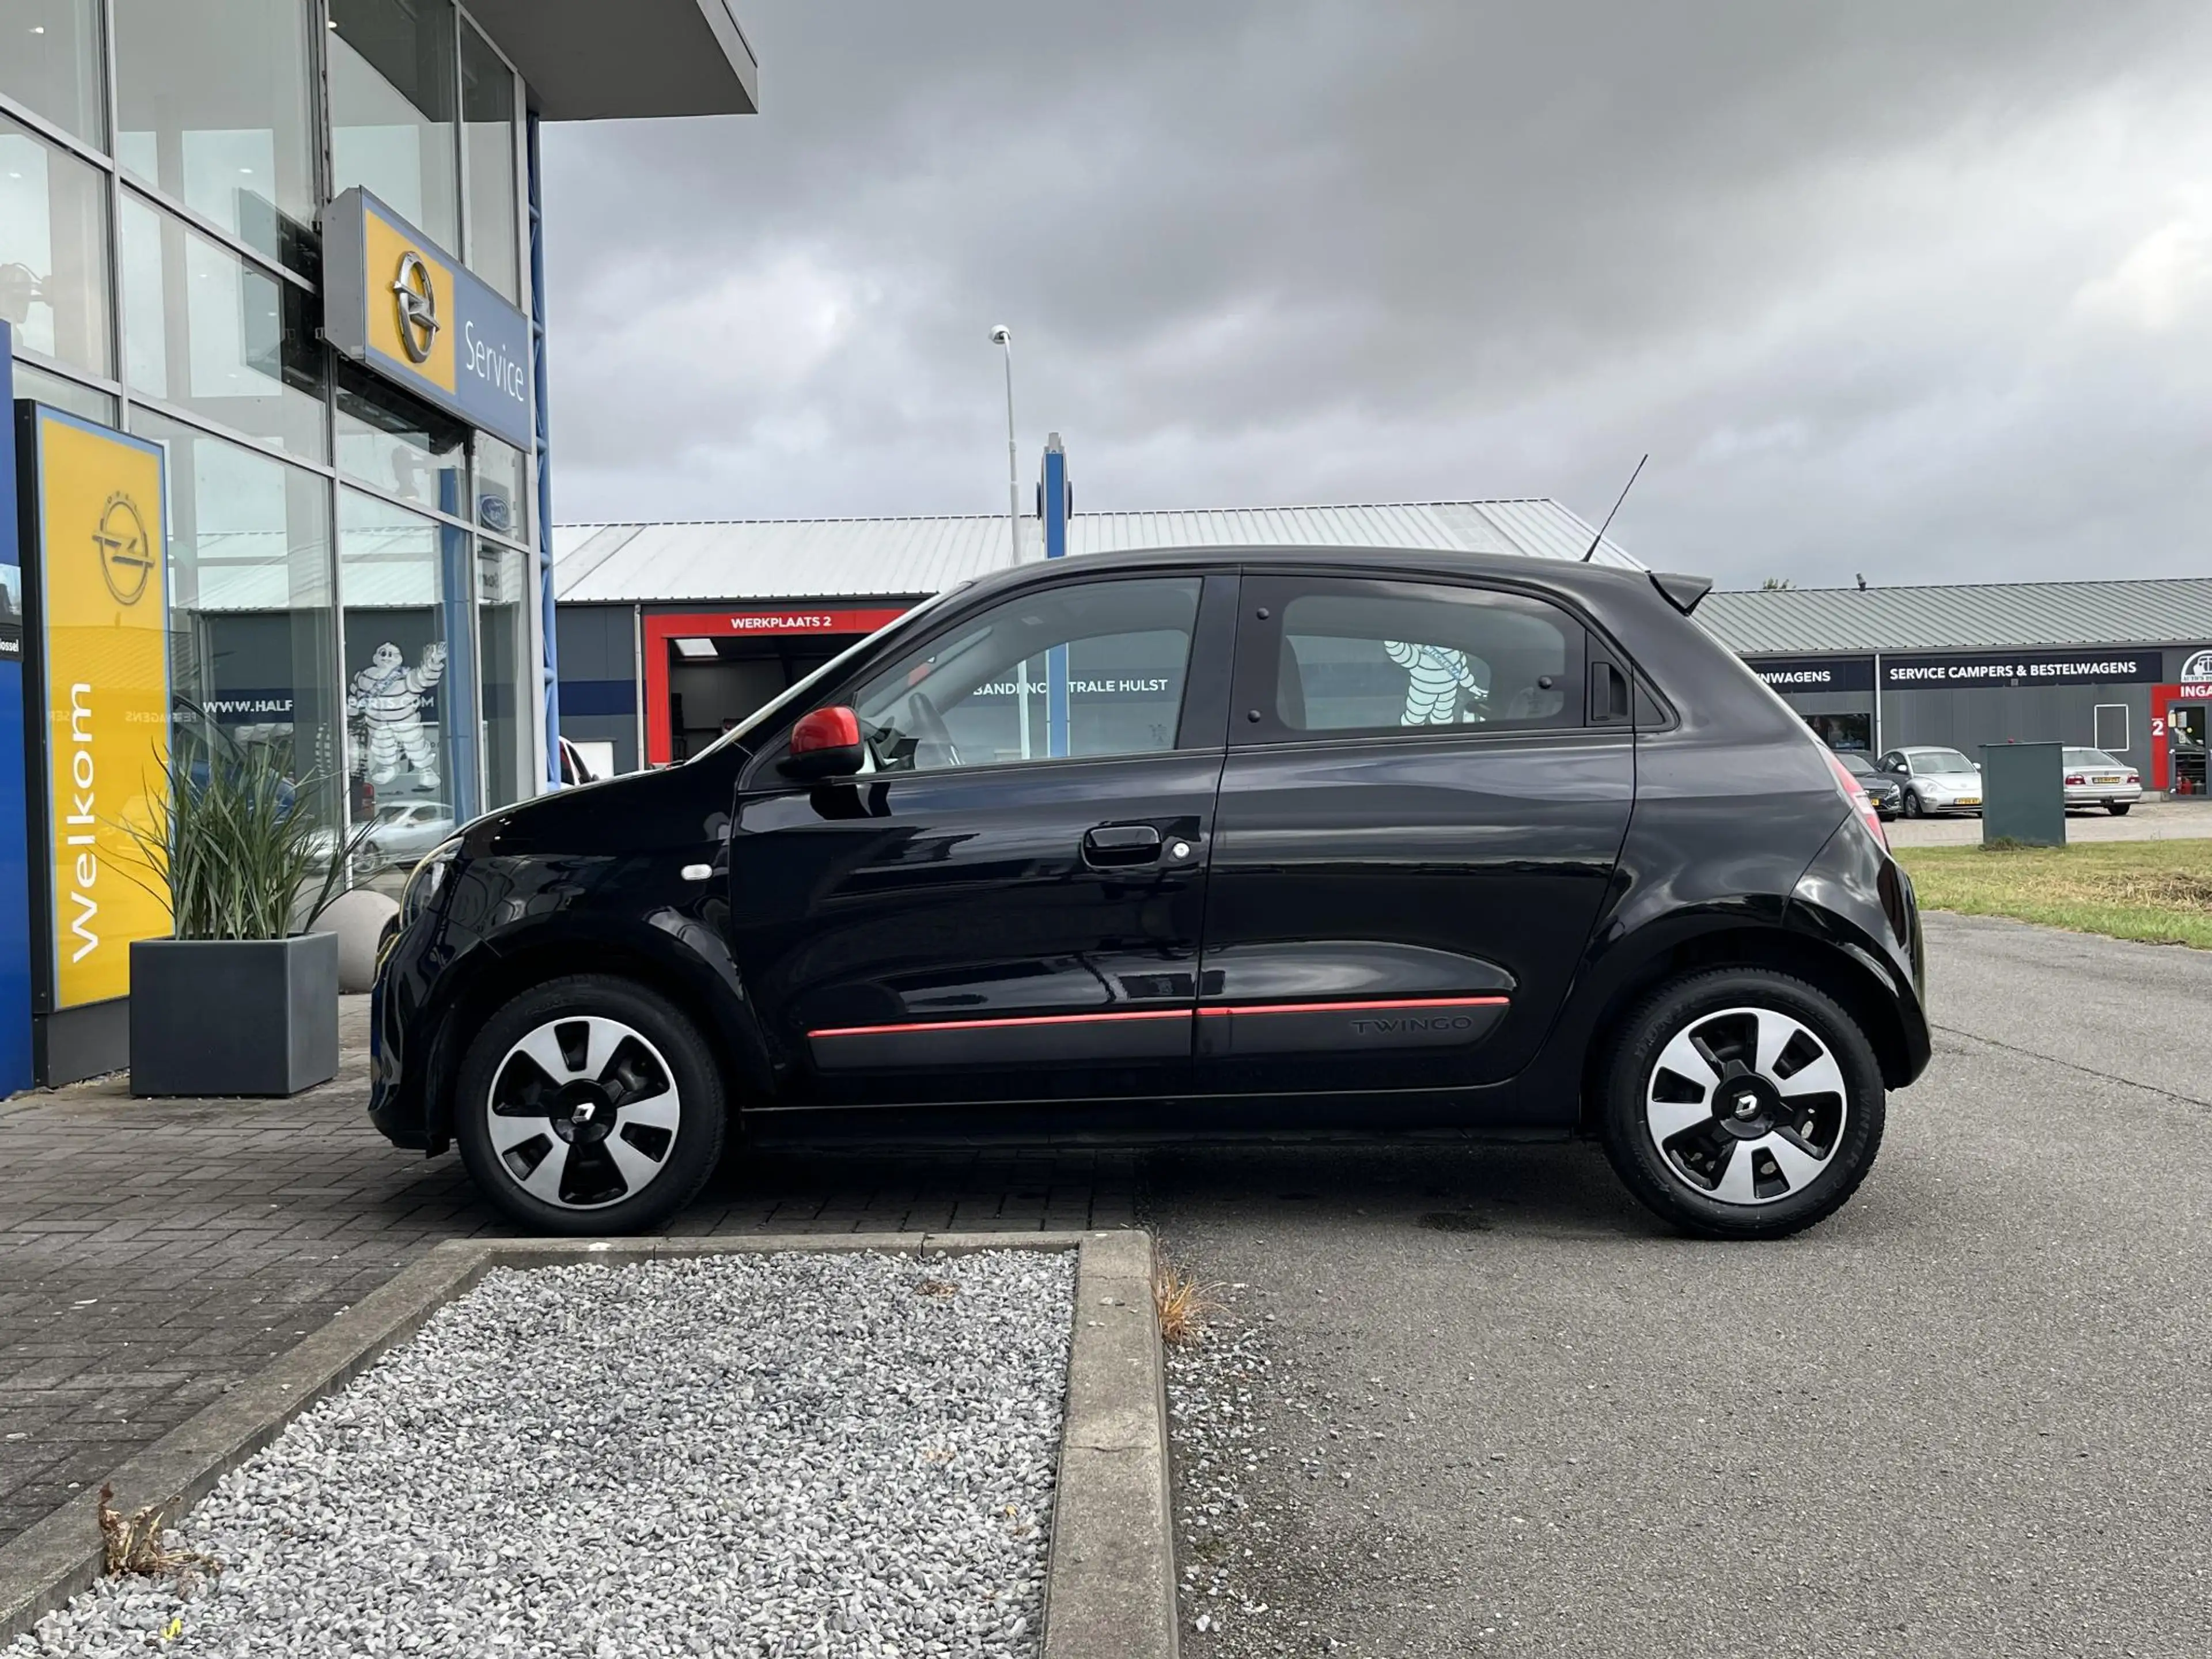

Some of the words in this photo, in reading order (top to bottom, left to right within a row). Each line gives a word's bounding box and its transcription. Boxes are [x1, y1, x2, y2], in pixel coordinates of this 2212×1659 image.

[465, 320, 524, 402] Service
[730, 617, 820, 629] WERKPLAATS
[823, 616, 832, 627] 2
[0, 638, 19, 652] ossel
[1757, 670, 1831, 684] NWAGENS
[1889, 666, 1946, 680] SERVICE
[1948, 665, 2013, 679] CAMPERS
[2016, 665, 2027, 676] &
[2030, 661, 2137, 676] BESTELWAGENS
[1119, 679, 1168, 691] HULST
[2152, 720, 2164, 736] 2
[66, 682, 99, 963] Welkom
[1351, 1015, 1473, 1035] TWINGO
